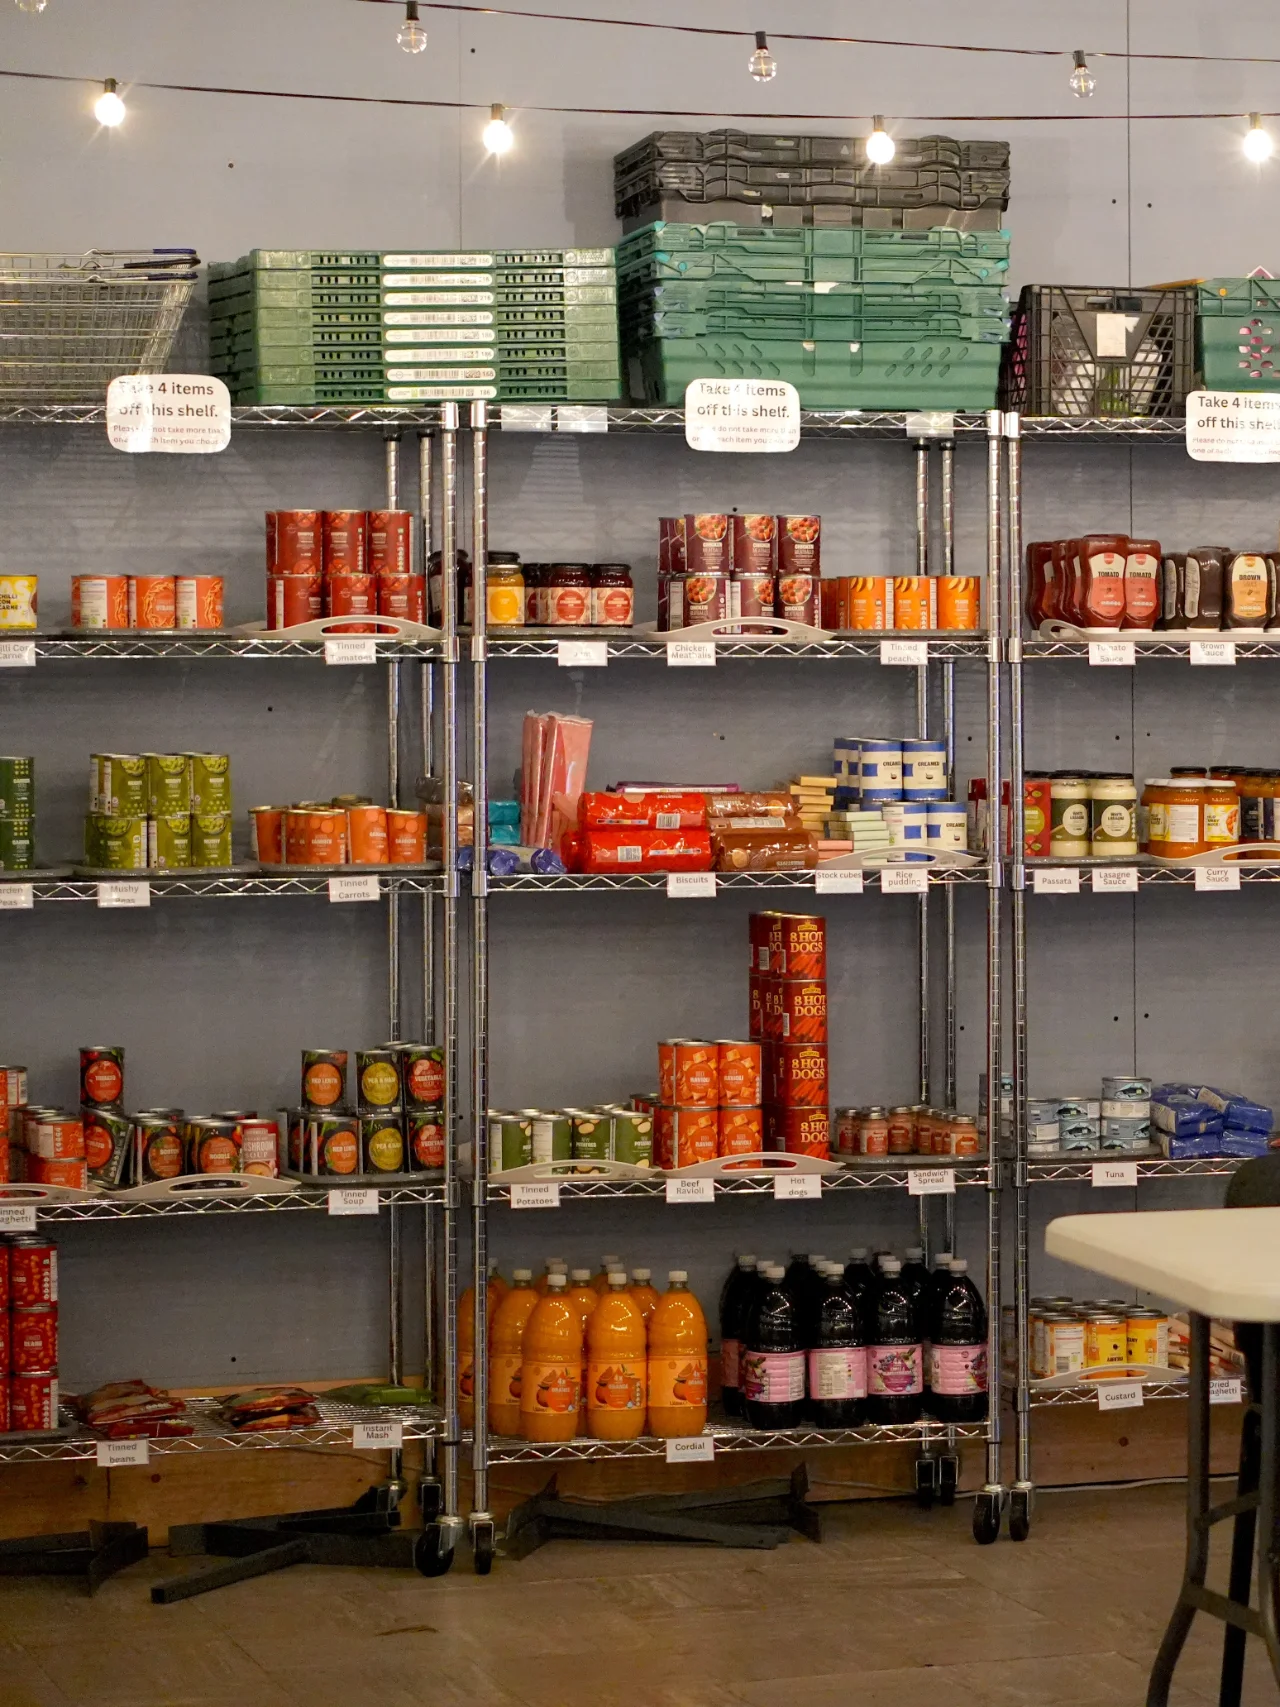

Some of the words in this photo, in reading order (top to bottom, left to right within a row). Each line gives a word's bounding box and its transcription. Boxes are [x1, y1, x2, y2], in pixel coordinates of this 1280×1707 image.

[158, 382, 168, 396] 4
[171, 382, 214, 396] items
[700, 382, 730, 396] Take
[746, 382, 786, 396] items
[1198, 396, 1228, 408] Take
[1232, 396, 1240, 408] 4
[178, 404, 218, 418] shelf.
[698, 404, 720, 418] off
[752, 404, 790, 418] shelf.
[1197, 416, 1216, 428] off
[1220, 418, 1245, 430] this
[336, 642, 366, 650] Tinned
[674, 644, 707, 652] Chicken
[890, 644, 918, 652] Tinned
[670, 652, 712, 660] Meatballs
[1100, 656, 1124, 664] Sauce
[816, 872, 838, 880] Stock
[840, 872, 862, 880] cubes
[896, 870, 913, 879] Rice
[1100, 871, 1131, 880] Lasagne
[1206, 868, 1228, 876] Curry
[676, 876, 708, 884] Biscuits
[888, 878, 922, 887] pudding
[1206, 875, 1229, 883] Sauce
[110, 885, 139, 894] Mushy
[338, 891, 370, 899] Carrots
[790, 932, 797, 942] 8
[799, 931, 823, 942] HOT
[790, 942, 823, 953] DOGS
[794, 996, 802, 1006] 8
[803, 995, 826, 1006] HOT
[794, 1006, 826, 1016] DOGS
[792, 1059, 799, 1069] 8
[801, 1058, 825, 1069] HOT
[792, 1068, 825, 1079] DOGS
[800, 1123, 808, 1132] 8
[810, 1122, 830, 1132] HOT
[801, 1132, 830, 1143] DOGS
[912, 1169, 948, 1178] Sandwich
[790, 1177, 806, 1185] Hot
[918, 1177, 944, 1185] Spread
[520, 1186, 549, 1194] Tinned
[676, 1186, 704, 1195] Ravioli
[789, 1188, 808, 1197] dogs
[343, 1198, 364, 1206] Soup
[516, 1198, 554, 1206] Potatoes
[1105, 1392, 1136, 1402] Custard
[363, 1424, 392, 1432] Instant
[108, 1443, 138, 1452] Tinned
[675, 1442, 705, 1452] Cordial
[109, 1455, 136, 1464] beans
